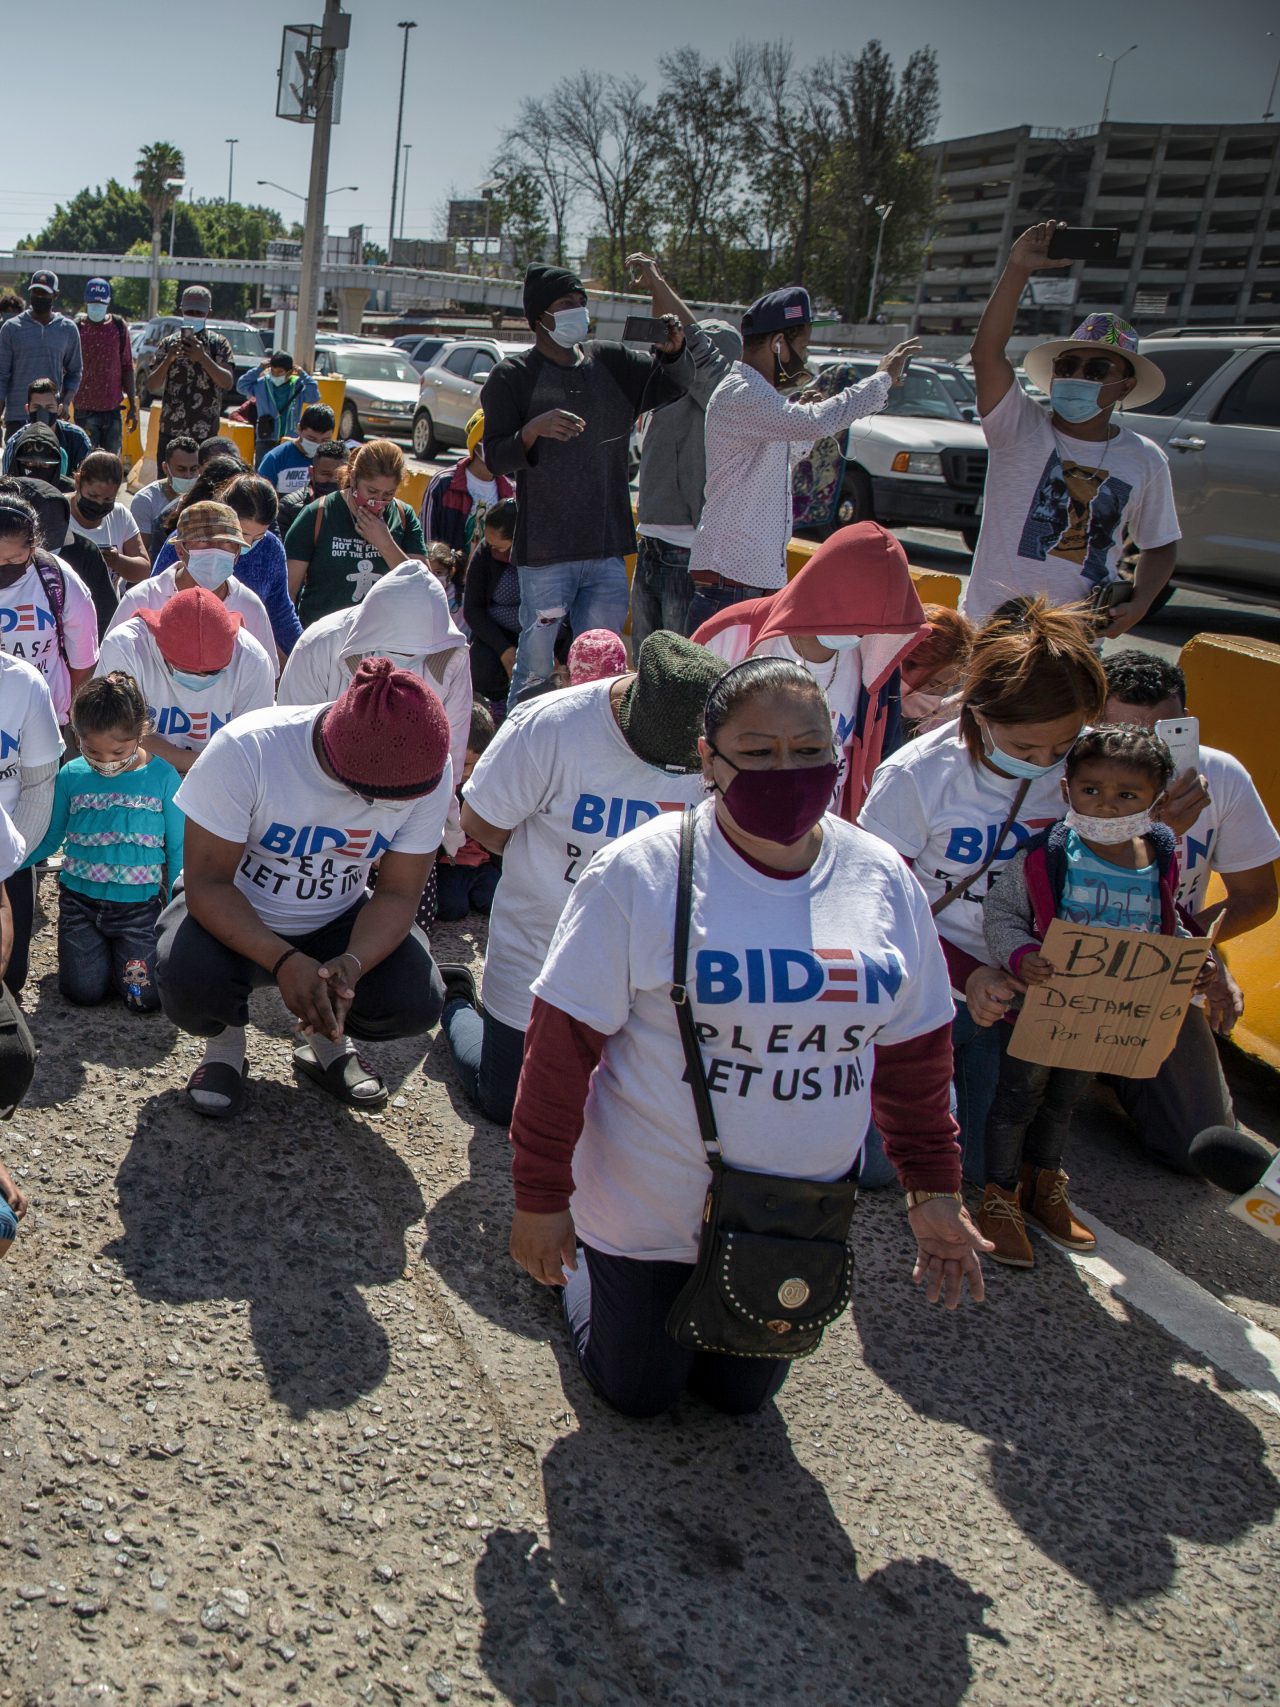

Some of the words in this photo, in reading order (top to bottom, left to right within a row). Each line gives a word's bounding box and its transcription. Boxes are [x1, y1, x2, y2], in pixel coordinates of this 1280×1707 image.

[285, 470, 307, 481] NIKE
[331, 541, 351, 551] HOT
[349, 551, 363, 559] THE
[240, 854, 290, 895] LET
[296, 878, 334, 900] US
[695, 948, 904, 1004] BIDEN
[1094, 1024, 1151, 1048] Favor
[772, 1066, 821, 1101] US
[833, 1055, 865, 1098] IN!
